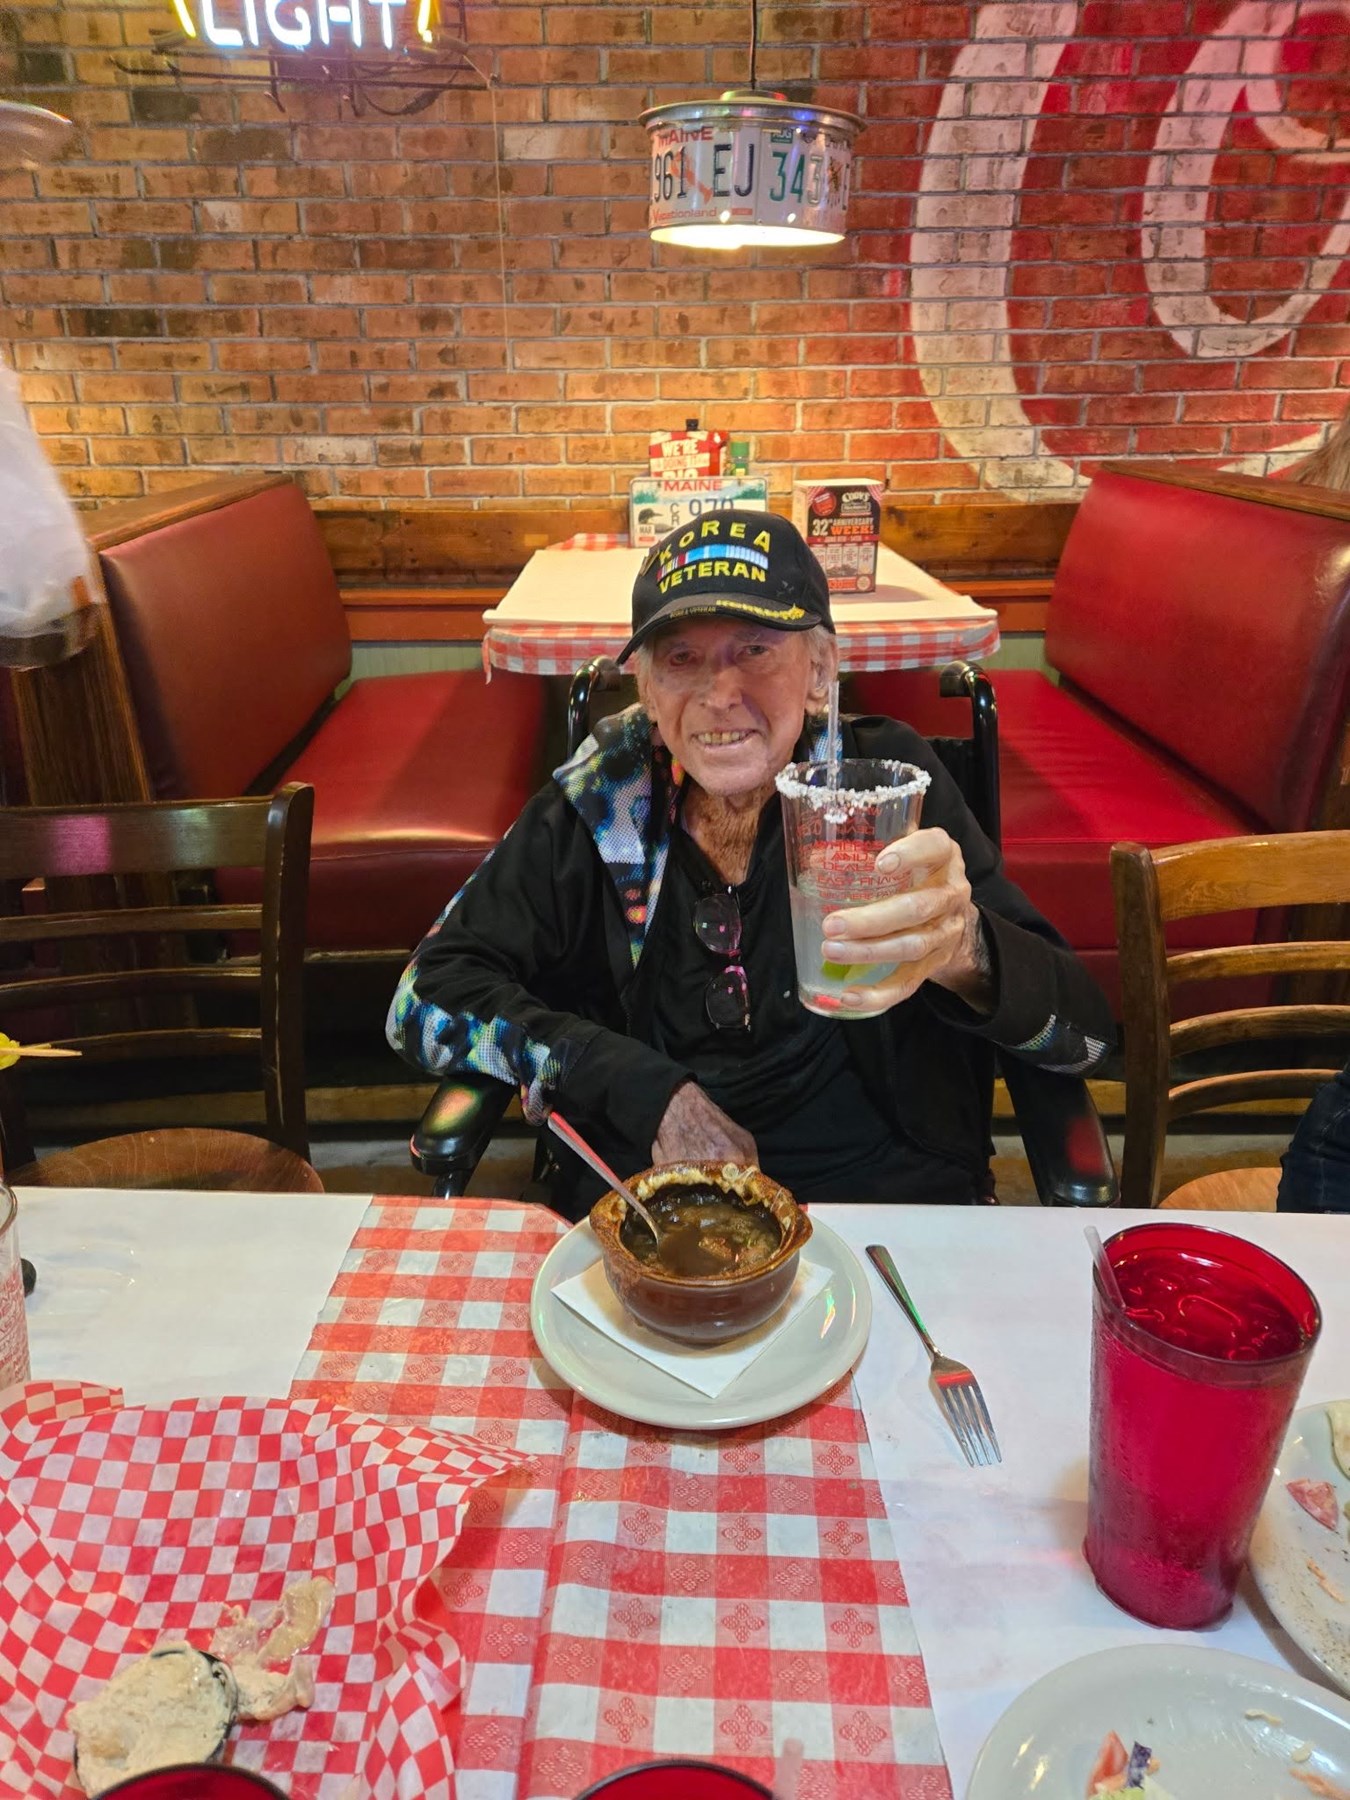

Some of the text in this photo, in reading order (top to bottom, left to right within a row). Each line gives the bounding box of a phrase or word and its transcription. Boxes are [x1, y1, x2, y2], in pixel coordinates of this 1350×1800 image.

[202, 0, 405, 50] LIGHT
[654, 143, 754, 202] 961 EJ
[770, 151, 823, 206] 343
[662, 439, 698, 457] WE'RE
[664, 480, 723, 491] MAINE
[659, 519, 771, 565] KOREA
[831, 525, 874, 535] WEEK!
[660, 560, 766, 594] VETERAN
[823, 861, 876, 872] DEALS
